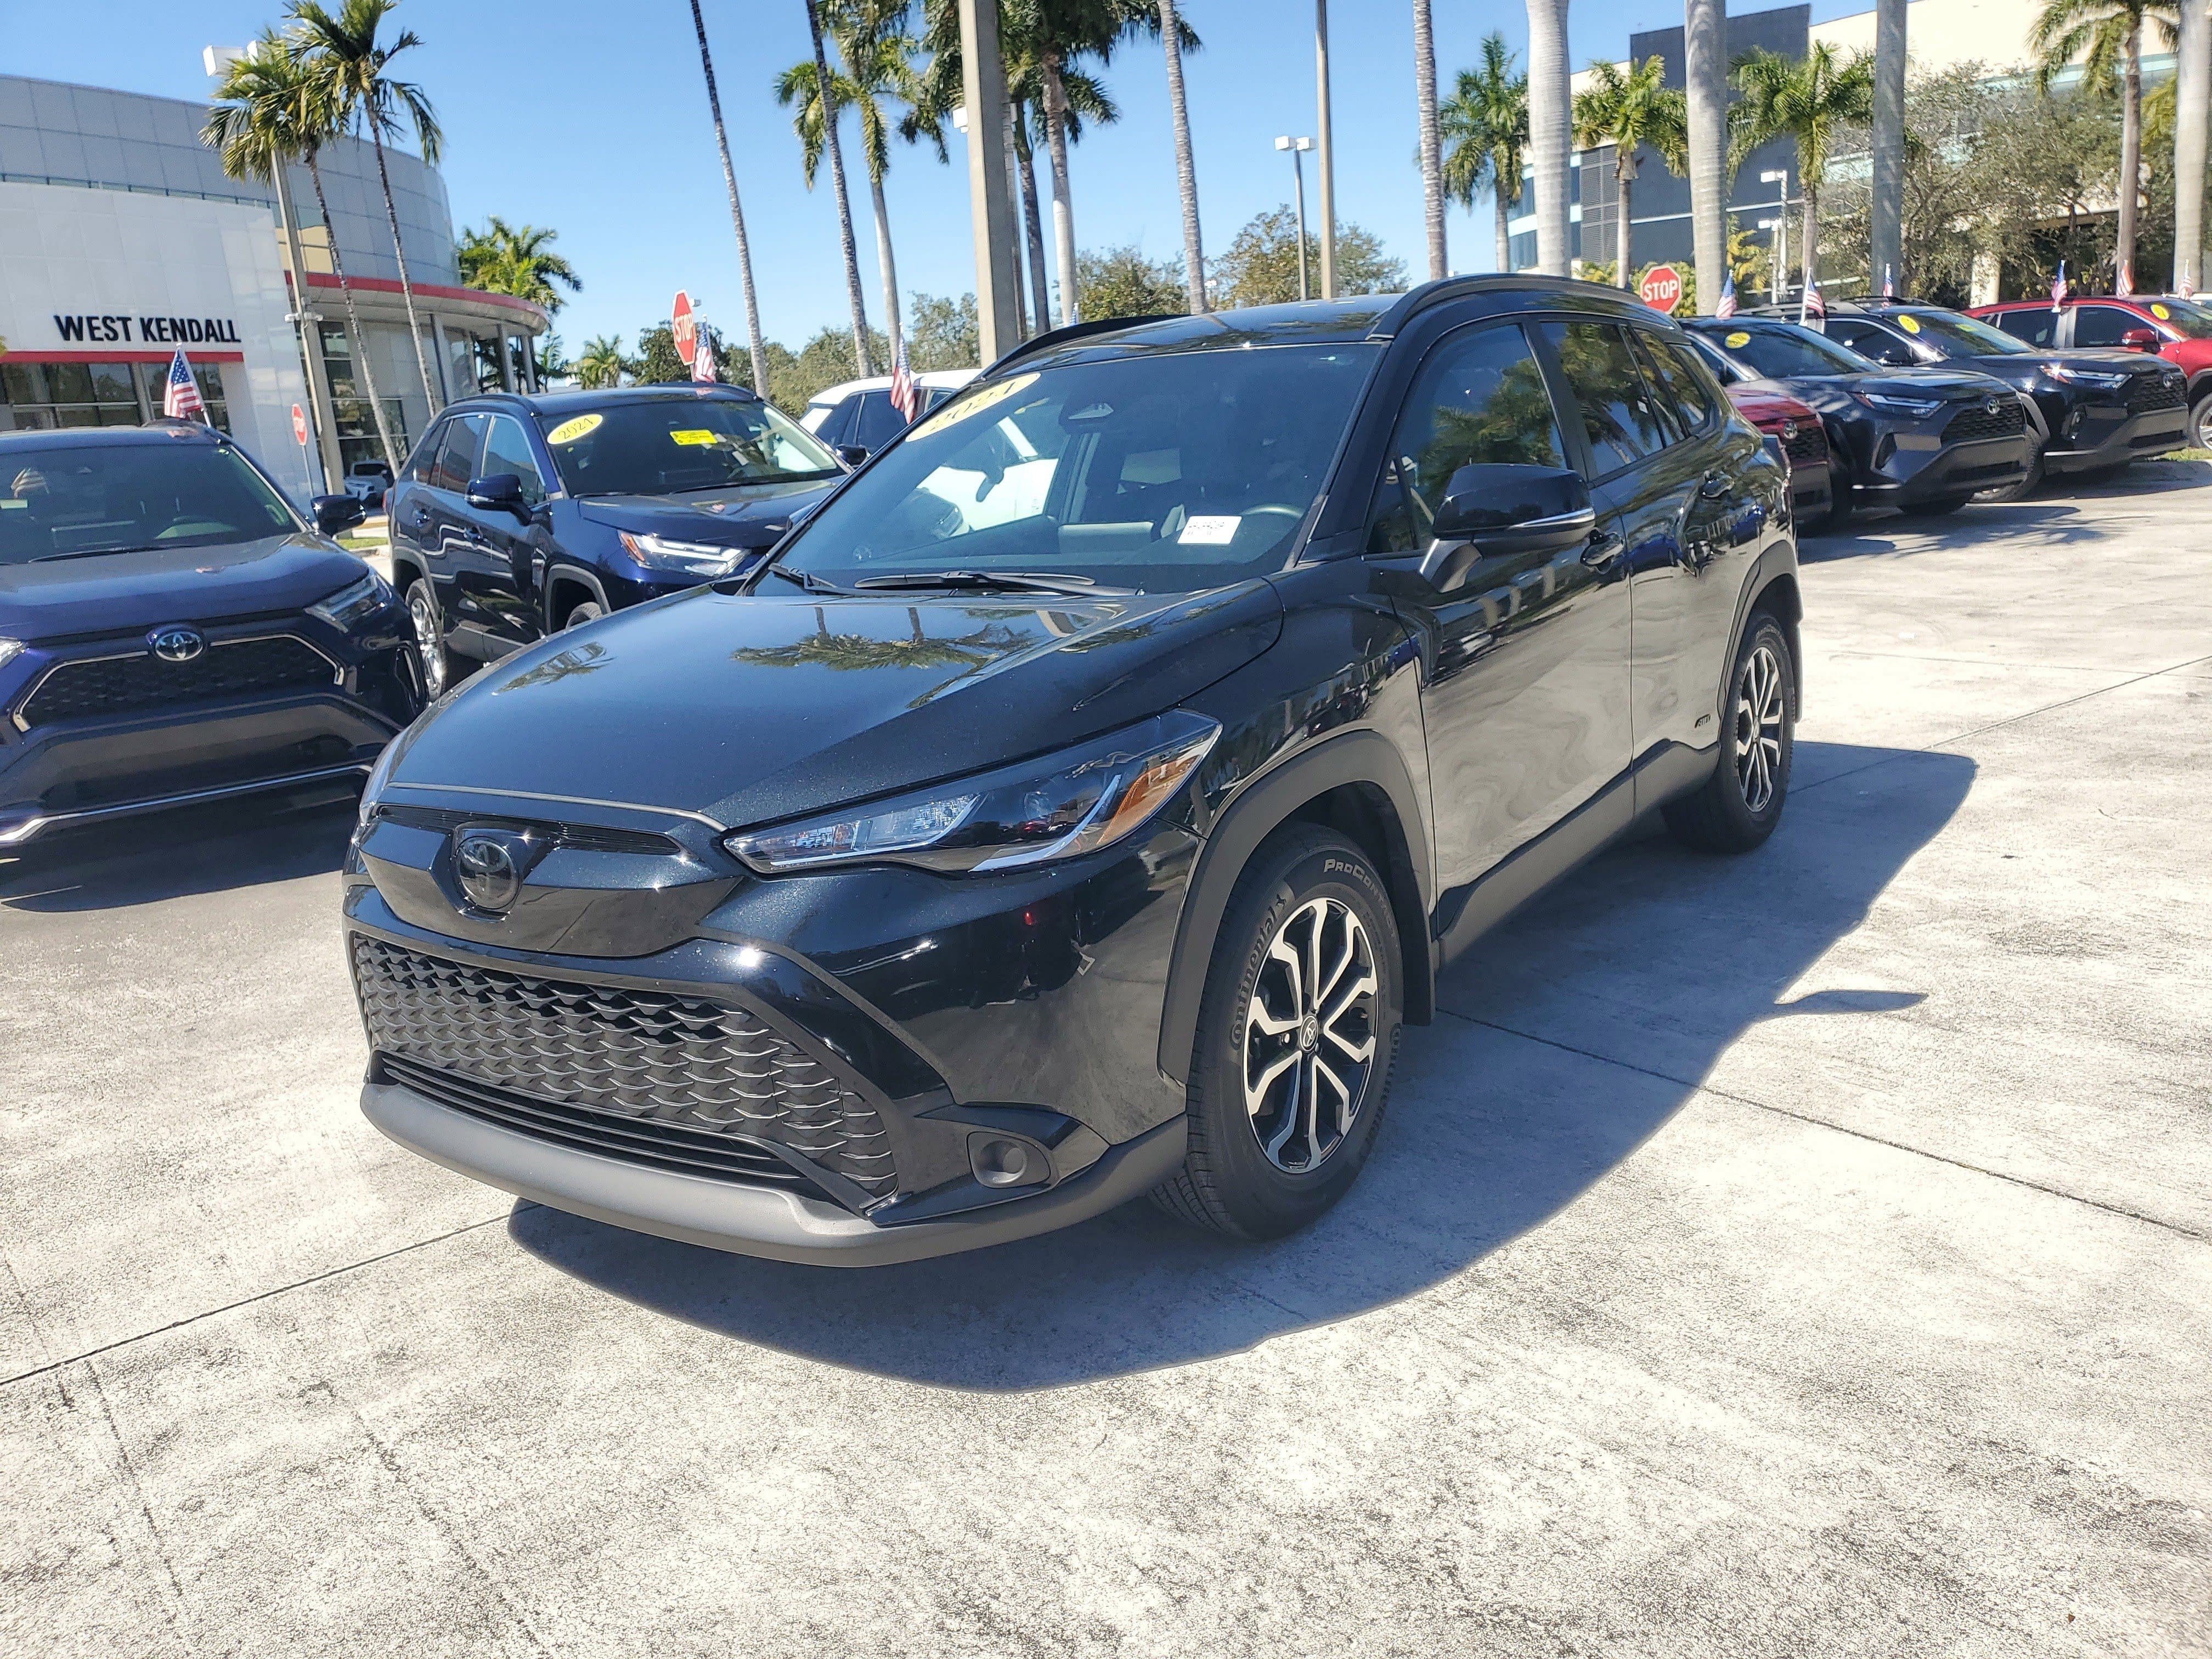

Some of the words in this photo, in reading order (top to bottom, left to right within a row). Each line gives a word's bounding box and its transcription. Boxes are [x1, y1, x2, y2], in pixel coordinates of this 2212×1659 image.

[1644, 280, 1678, 302] STOP
[53, 315, 132, 341] WEST
[139, 317, 241, 343] KENDALL
[674, 313, 693, 343] STOP
